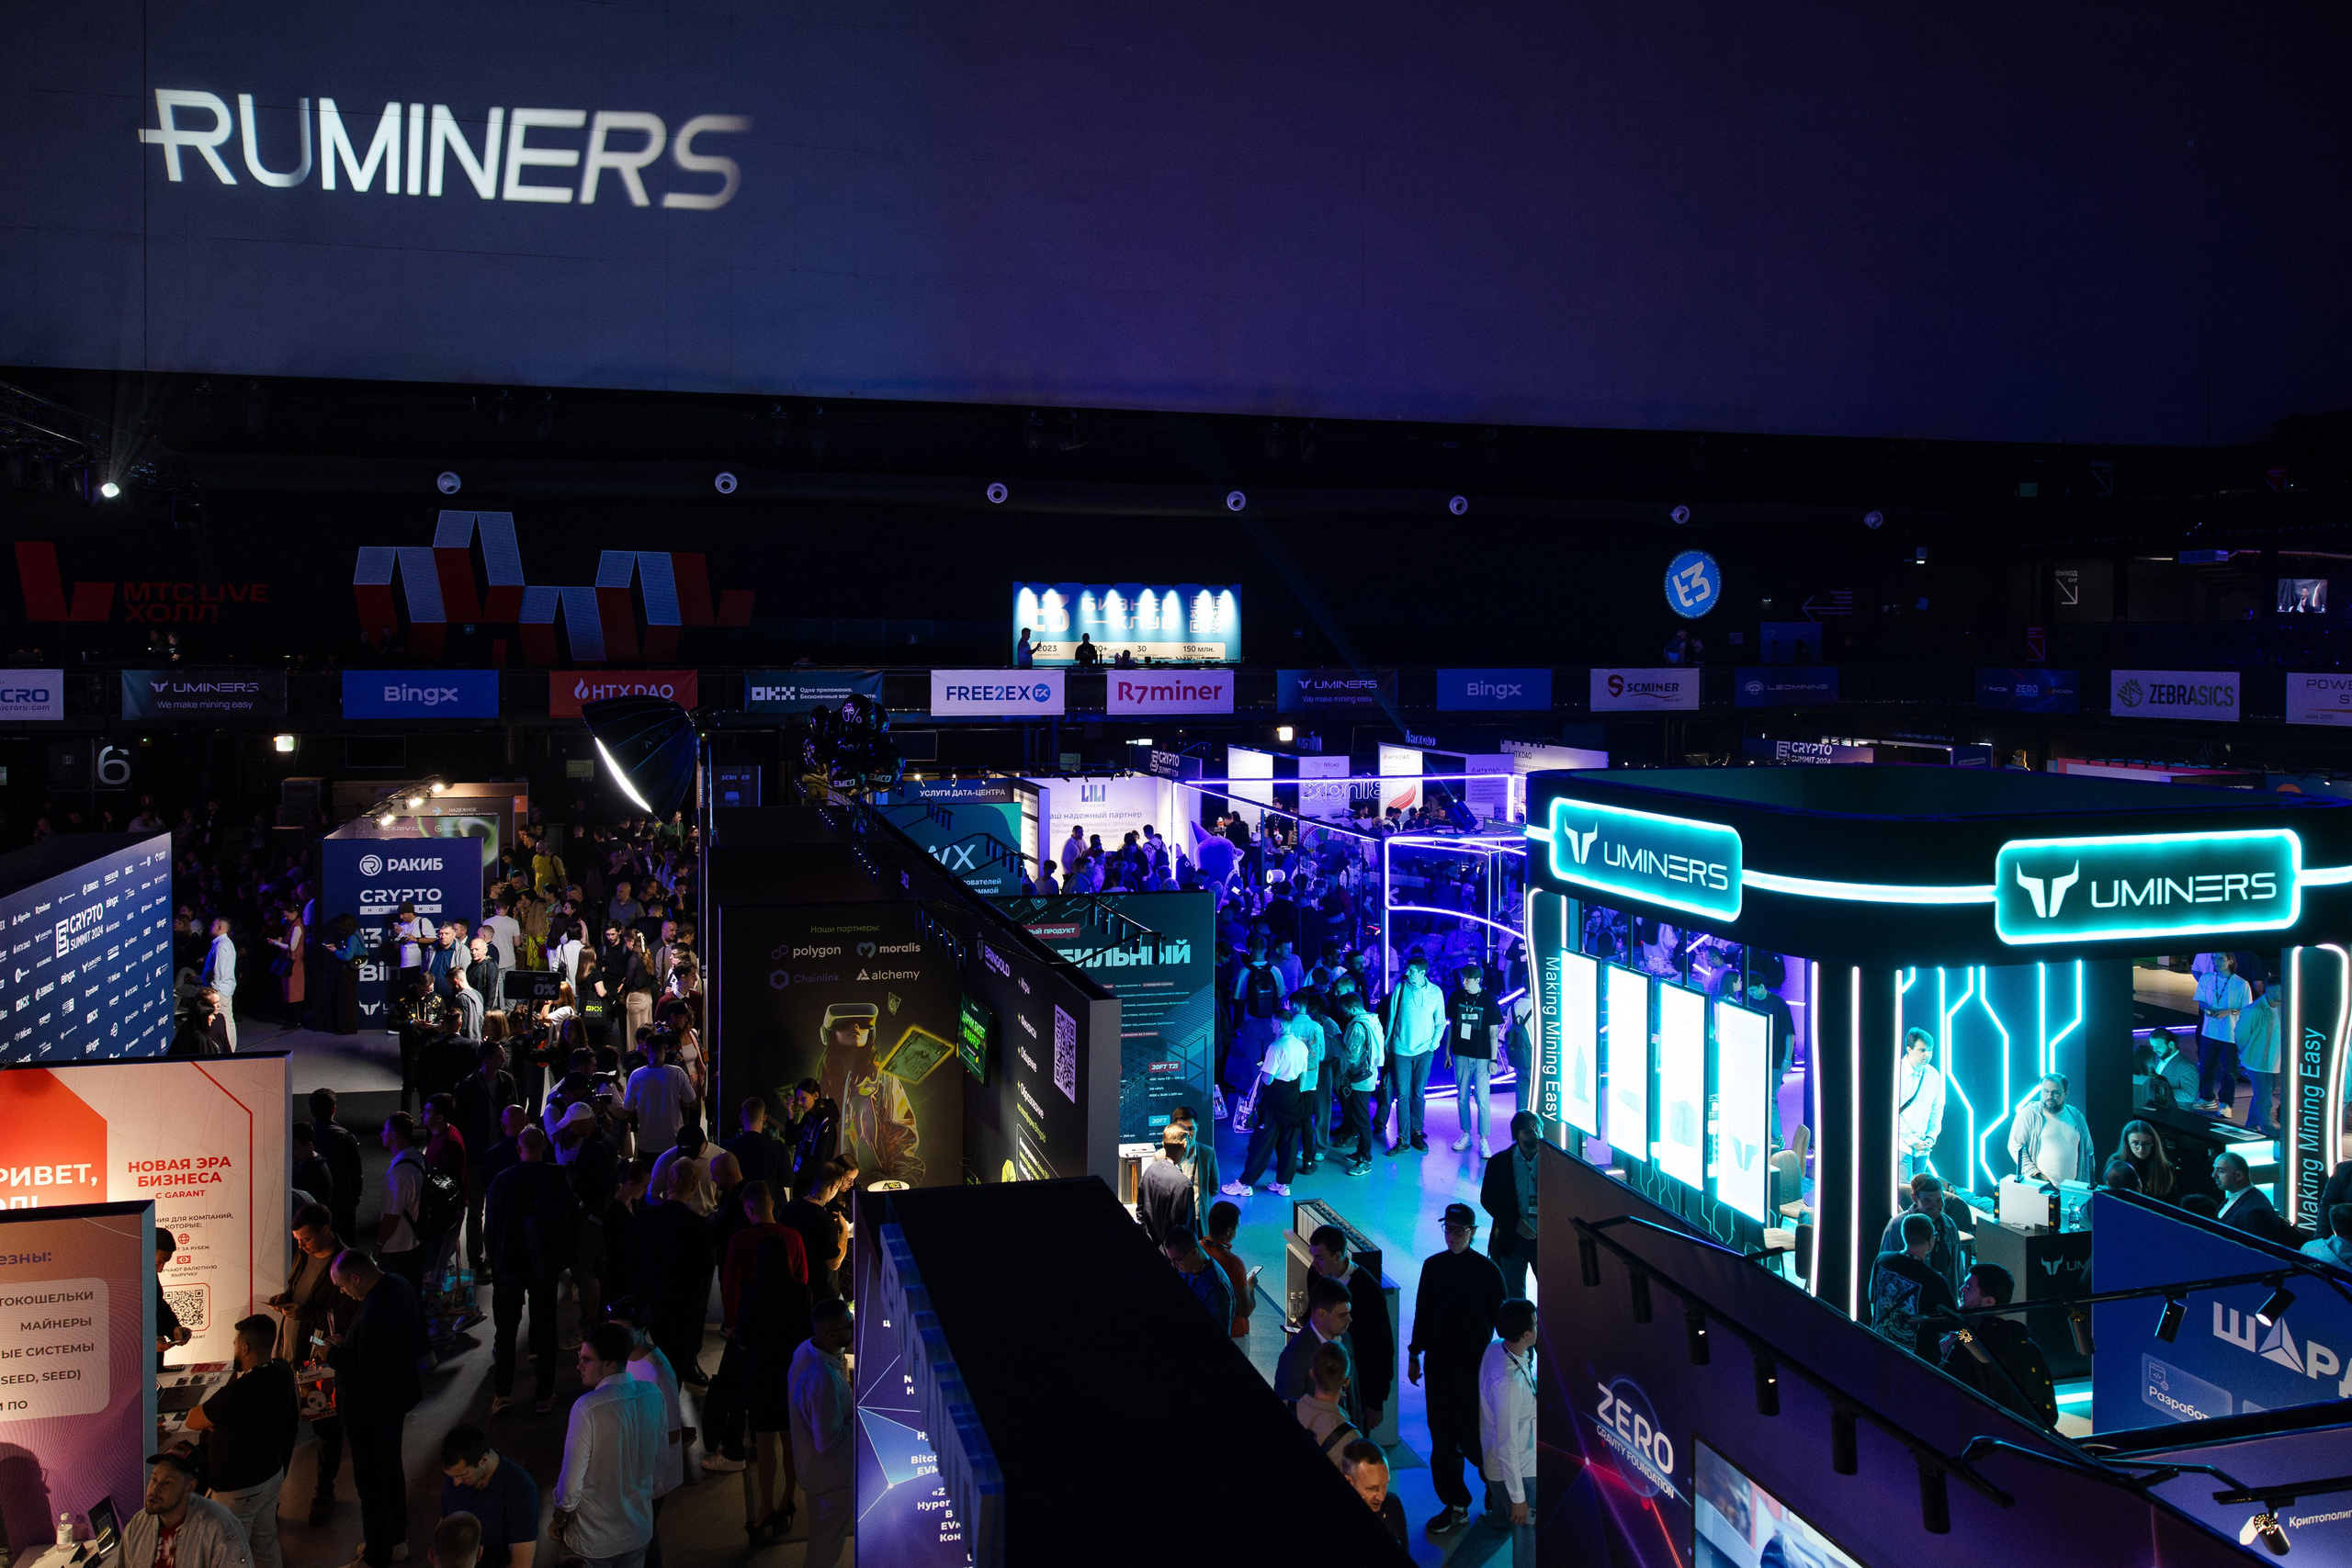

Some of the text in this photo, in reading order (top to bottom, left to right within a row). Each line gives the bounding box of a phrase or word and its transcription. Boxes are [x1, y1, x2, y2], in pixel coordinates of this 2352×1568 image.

[138, 87, 751, 210] RUMINERS
[202, 583, 269, 603] LIVE
[123, 603, 219, 624] ХОЛЛ
[173, 682, 259, 693] UMINERS
[593, 683, 674, 699] HTX DAO
[946, 685, 1031, 700] FREE2EX
[1117, 680, 1222, 705] R7miner
[1314, 680, 1377, 689] UMINERS
[1627, 682, 1679, 692] SCMINER
[1768, 682, 1829, 691] LEOMINING
[2016, 684, 2039, 693] ZERO
[752, 686, 795, 700] OKX
[1333, 695, 1354, 705] mining
[1355, 696, 1373, 705] easy
[2149, 683, 2234, 707] ZEBRASICS
[157, 700, 254, 711] We make mining easy
[1791, 741, 1832, 755] CRYPTO
[96, 745, 132, 785] 6
[1159, 751, 1180, 767] CRYPTO
[952, 789, 1006, 797] ДАТА-ЦЕНТРА
[1064, 811, 1106, 820] надежный
[1109, 811, 1142, 819] партнер
[388, 858, 443, 872] РАКИБ
[1604, 841, 1728, 891] UMINERS
[359, 888, 442, 903] CRYPTO
[2091, 872, 2278, 908] UMINERS
[70, 902, 104, 934] CRYPTO
[810, 924, 881, 933] Наши партнеры:
[1044, 927, 1076, 935] ПРОДУКТ
[70, 924, 104, 951] SUMMIT 2024
[793, 942, 922, 958] polygon moralis
[1057, 939, 1191, 969] БИЛЬНЫЙ
[358, 961, 401, 982] Bin
[794, 969, 920, 984] Chainlink alchemy
[533, 983, 557, 996] 0%
[1542, 955, 1561, 1122] Making Mining Easy
[2298, 1027, 2326, 1232] Making Mining Easy
[128, 1156, 232, 1173] НОВАЯ ЭРА
[137, 1171, 222, 1188] БИЗНЕСА
[164, 1190, 206, 1199] GARANT
[188, 1213, 233, 1222] КОМПАНИЙ,
[20, 1316, 92, 1332] МАЙНЕРЫ
[26, 1342, 95, 1358] СИСТЕМЫ
[1, 1369, 82, 1385] SEED, SEED)
[7, 1400, 28, 1411] ПО
[1597, 1382, 1675, 1475] ZERO
[1596, 1425, 1675, 1500] GRAVITY FOUNDATION
[917, 1499, 951, 1511] Hyper
